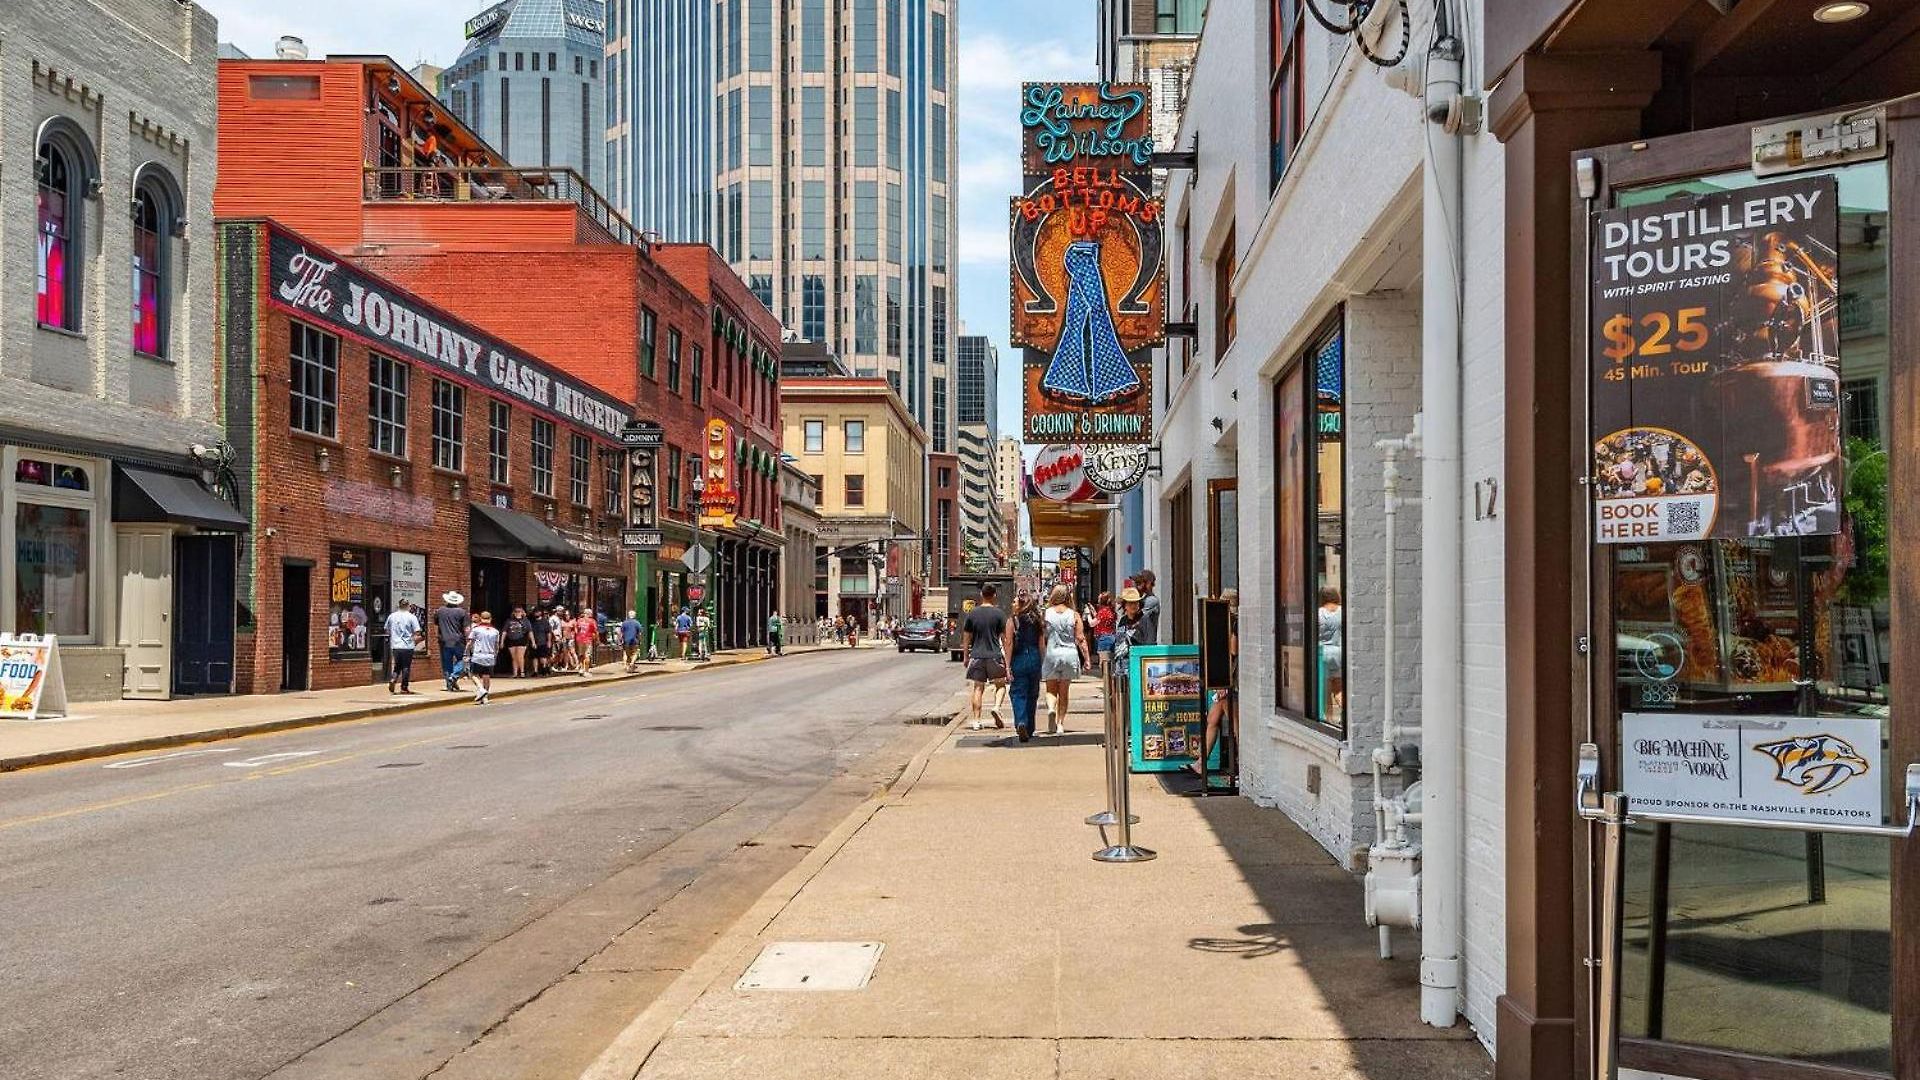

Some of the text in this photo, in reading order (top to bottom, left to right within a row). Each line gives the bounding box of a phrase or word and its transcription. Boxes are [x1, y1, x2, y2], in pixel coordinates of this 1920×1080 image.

[1020, 82, 1145, 139] Lainey
[1053, 166, 1124, 189] BELL
[1020, 189, 1161, 223] BOTTOMS
[1069, 207, 1108, 236] UP
[1604, 189, 1822, 249] DISTILLERY
[1604, 240, 1731, 281] TOURS
[1603, 272, 1732, 299] WITH SPIRIT TASTING
[279, 246, 627, 437] The JOHNNY CASH MUSEUM
[1602, 306, 1709, 364] $25
[1603, 361, 1708, 382] 45 Min. Tour
[1031, 411, 1145, 435] COOKIN' & DRINKIN'
[624, 434, 661, 442] JOHNNY
[1097, 451, 1138, 471] KEYS
[631, 448, 653, 525] CASH
[1601, 502, 1659, 520] BOOK
[624, 534, 662, 545] MUSEUM
[1601, 521, 1659, 538] HERE
[0, 663, 38, 679] FOOD
[1634, 739, 1730, 761] BIG MACHINE
[1681, 760, 1729, 781] VODKA
[1631, 798, 1662, 806] PROUD
[1665, 799, 1709, 809] SPONSOR
[1729, 803, 1748, 811] THE
[1751, 804, 1806, 815] NASHVILLE
[1809, 807, 1871, 818] PREDATORS
